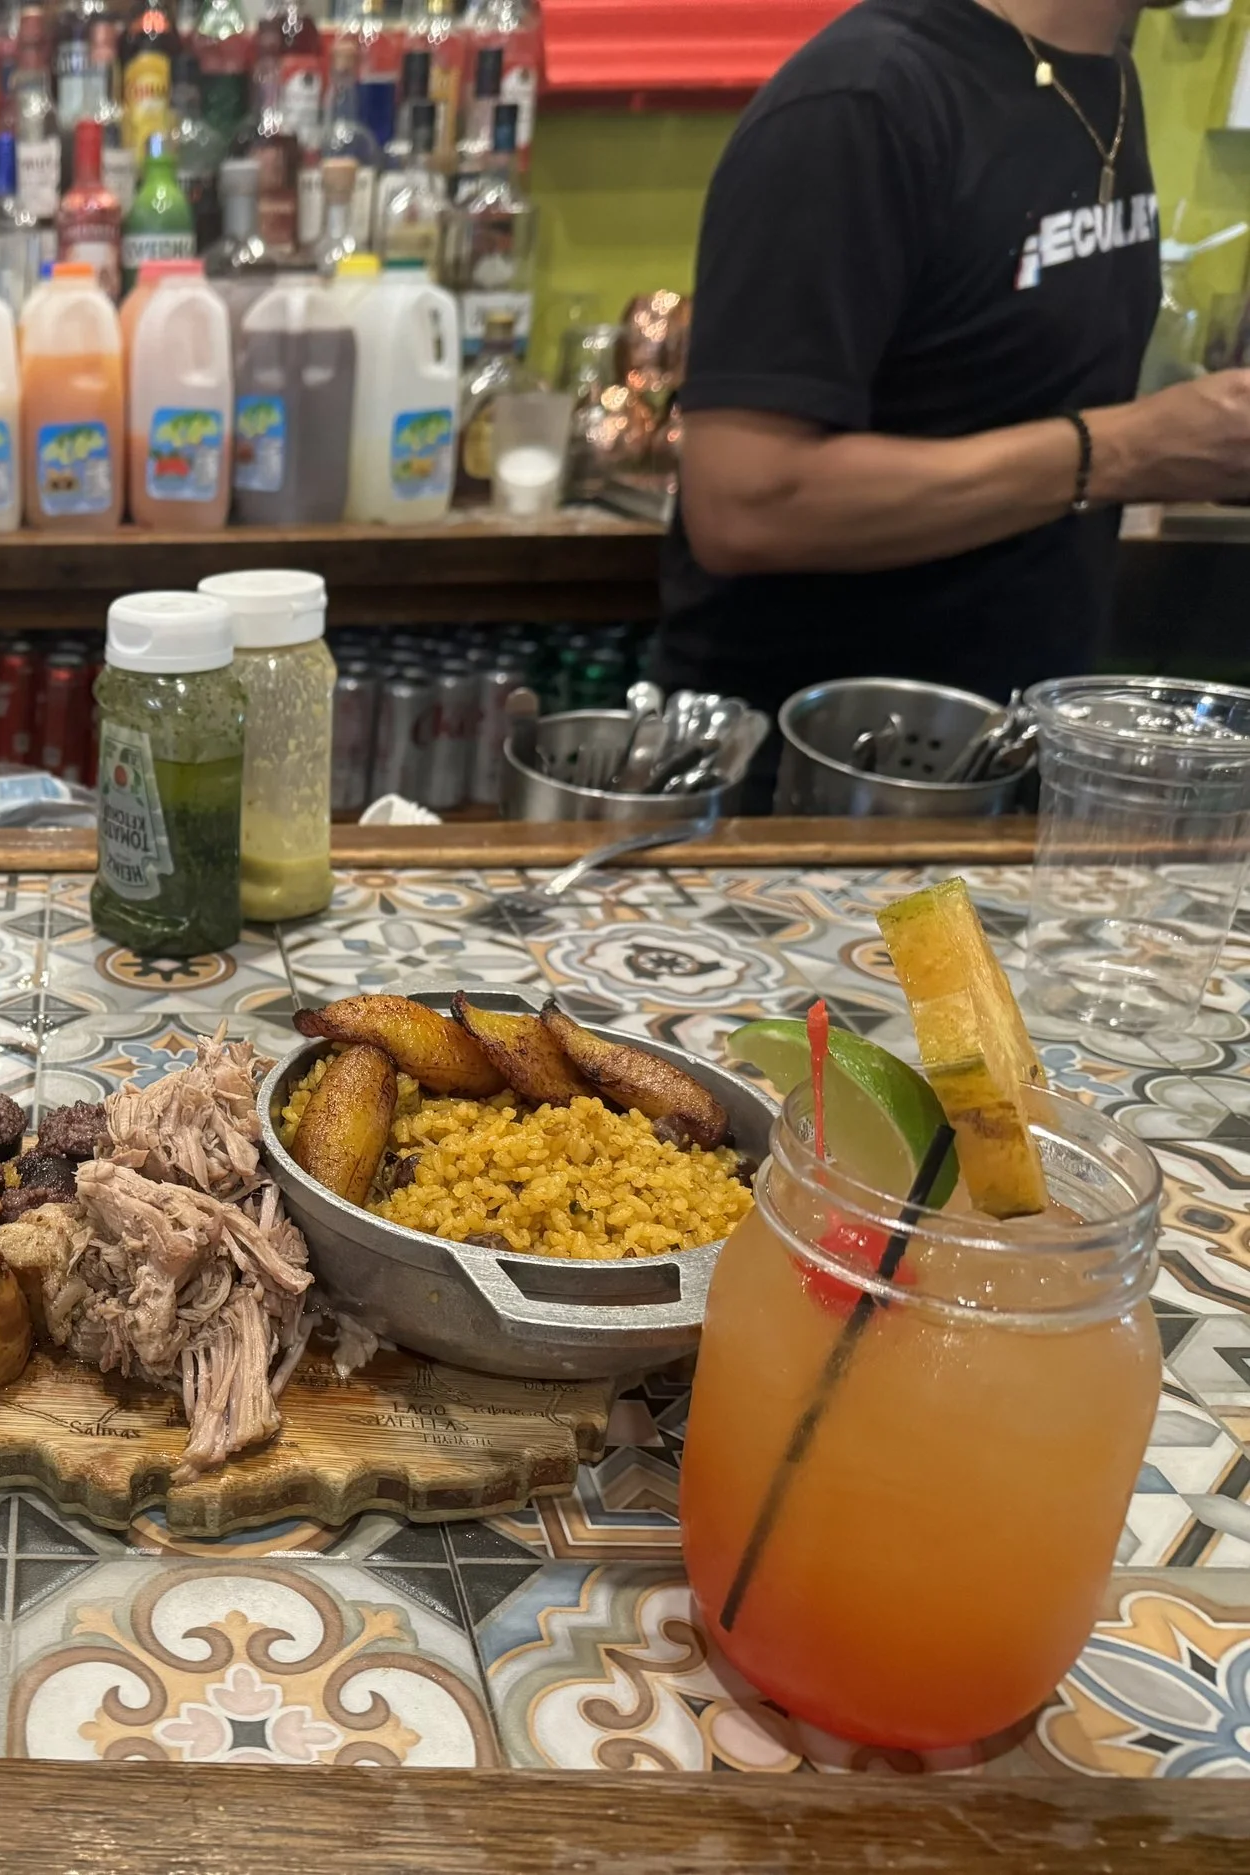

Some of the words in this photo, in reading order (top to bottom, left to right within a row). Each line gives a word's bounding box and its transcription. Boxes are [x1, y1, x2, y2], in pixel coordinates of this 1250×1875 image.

[104, 824, 151, 852] TOMAT
[106, 853, 144, 883] HEINZ
[393, 1401, 446, 1416] LAGO
[69, 1420, 141, 1439] Salinas
